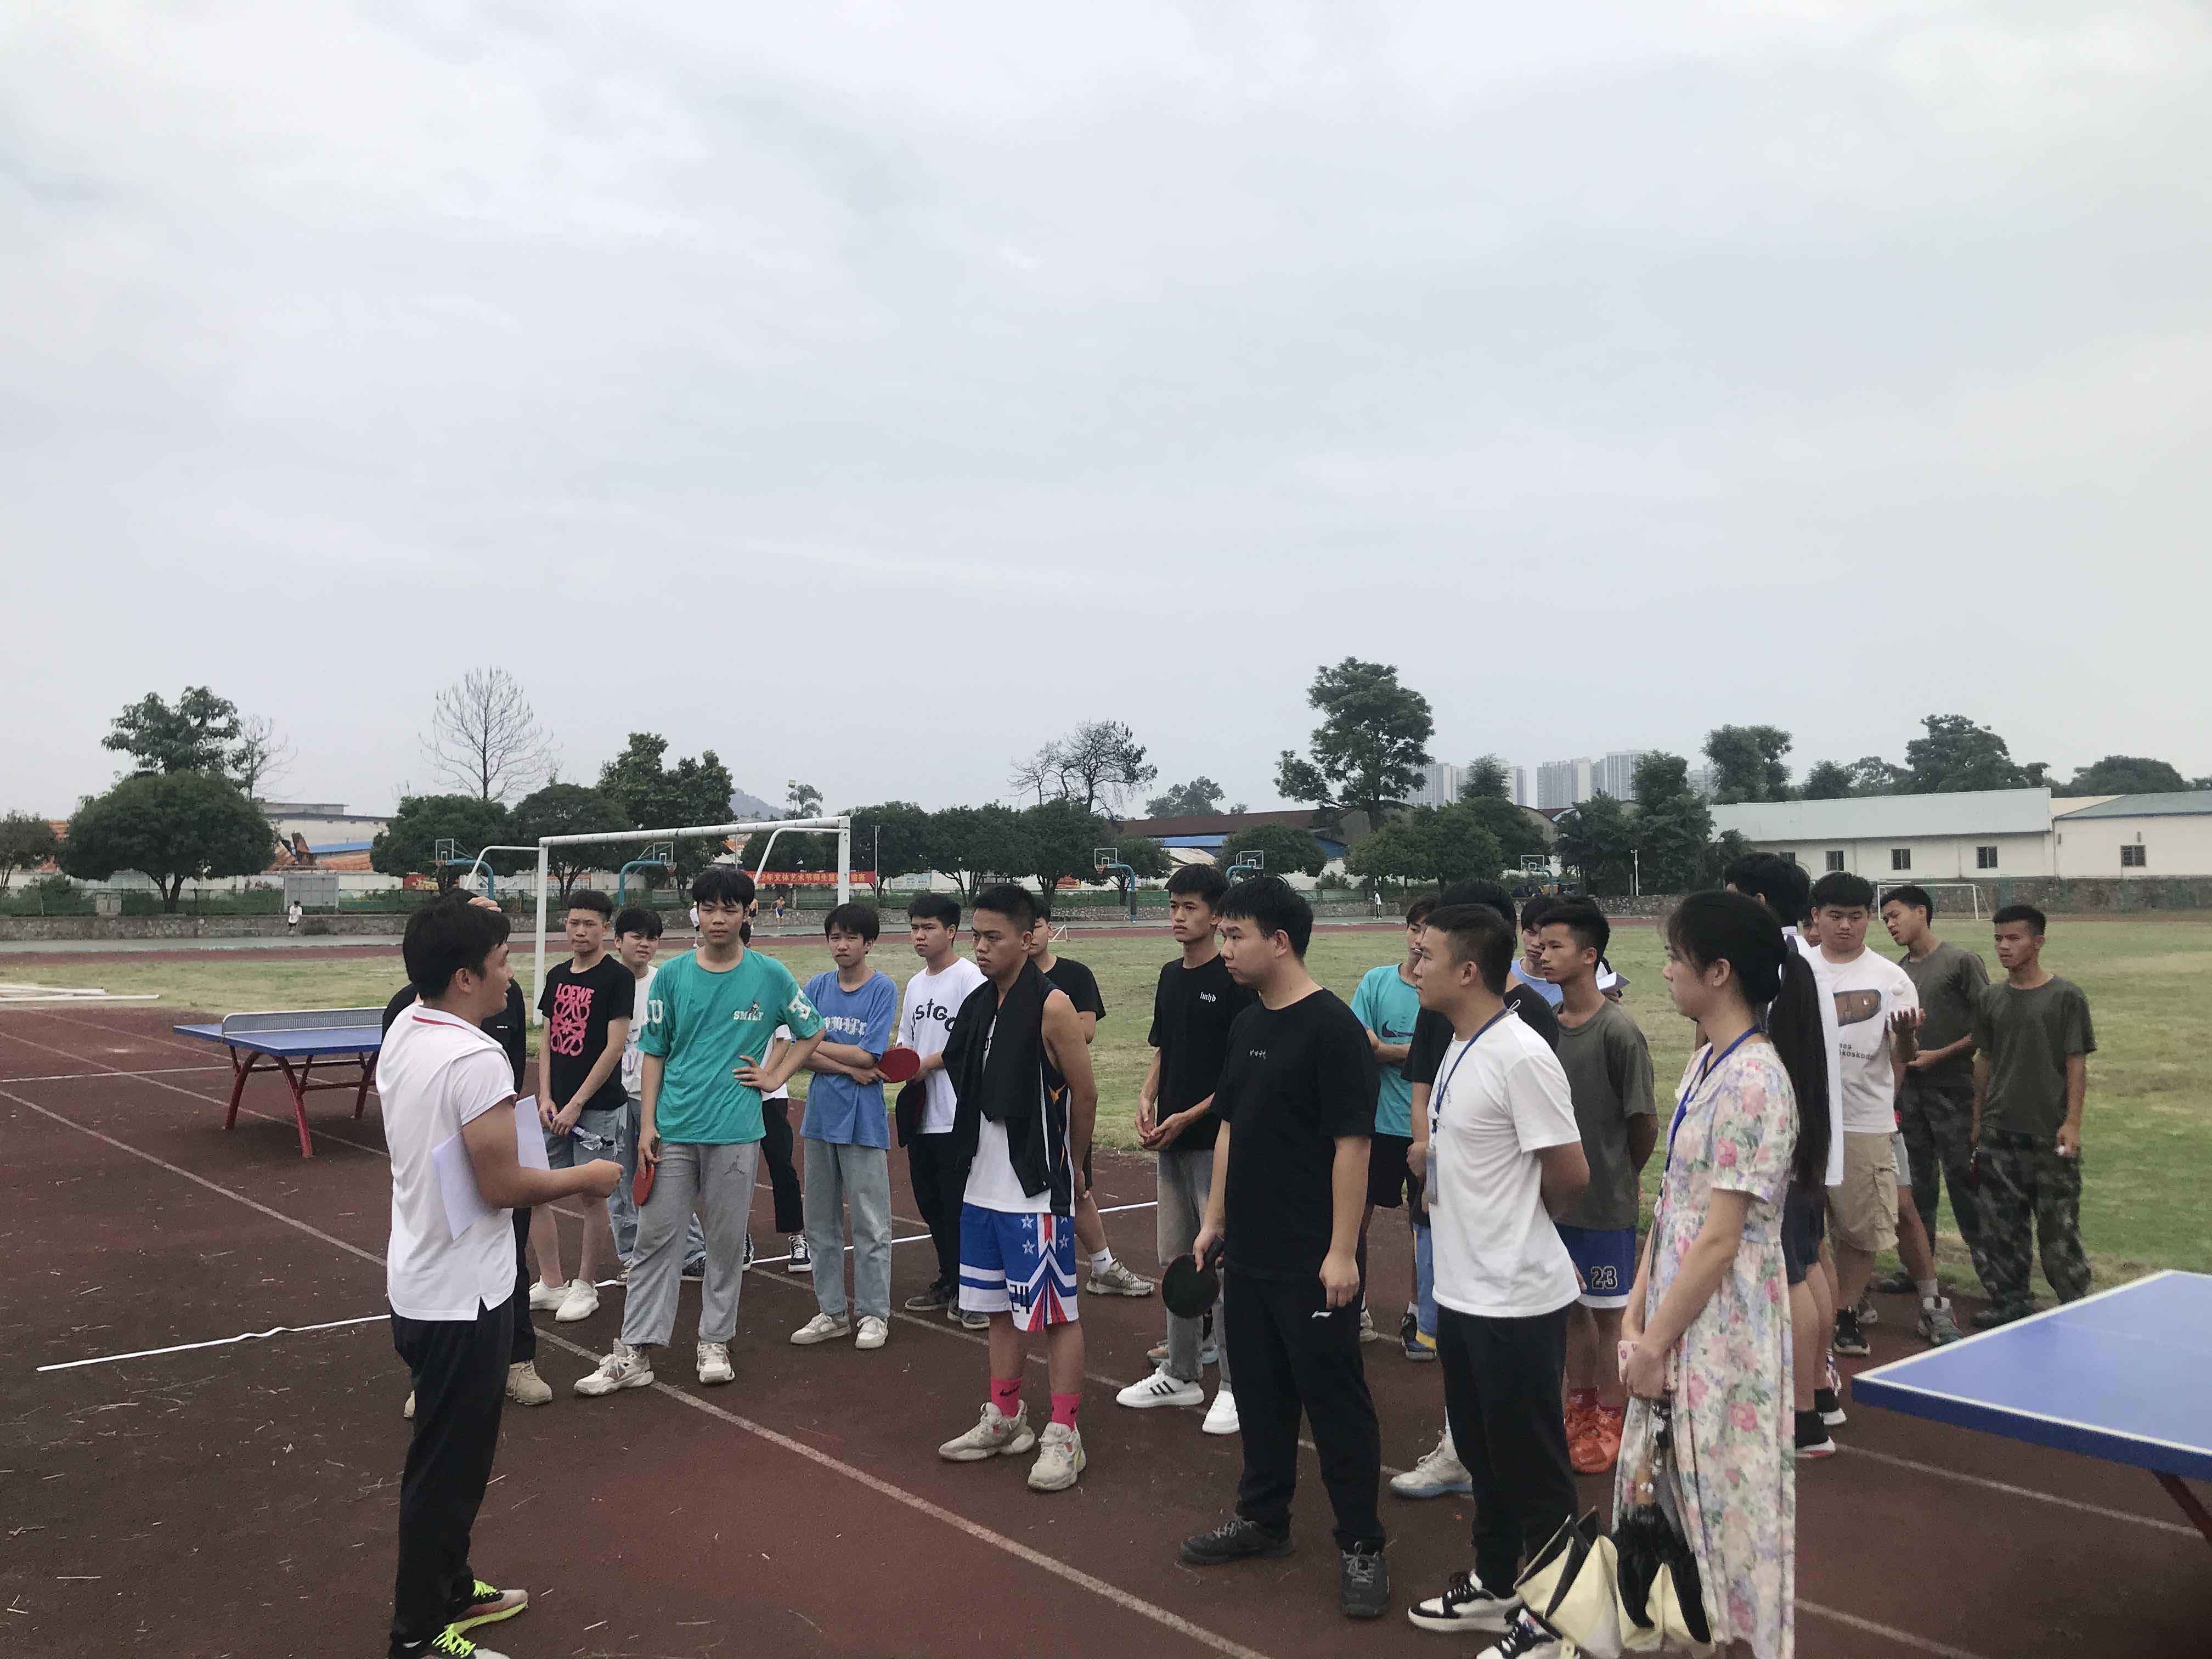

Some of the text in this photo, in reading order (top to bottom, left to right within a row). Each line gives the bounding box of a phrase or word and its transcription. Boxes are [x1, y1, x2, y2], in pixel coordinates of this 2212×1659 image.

[555, 983, 595, 1004] LOEWE
[1590, 1266, 1618, 1289] 23
[1009, 1284, 1030, 1314] 24
